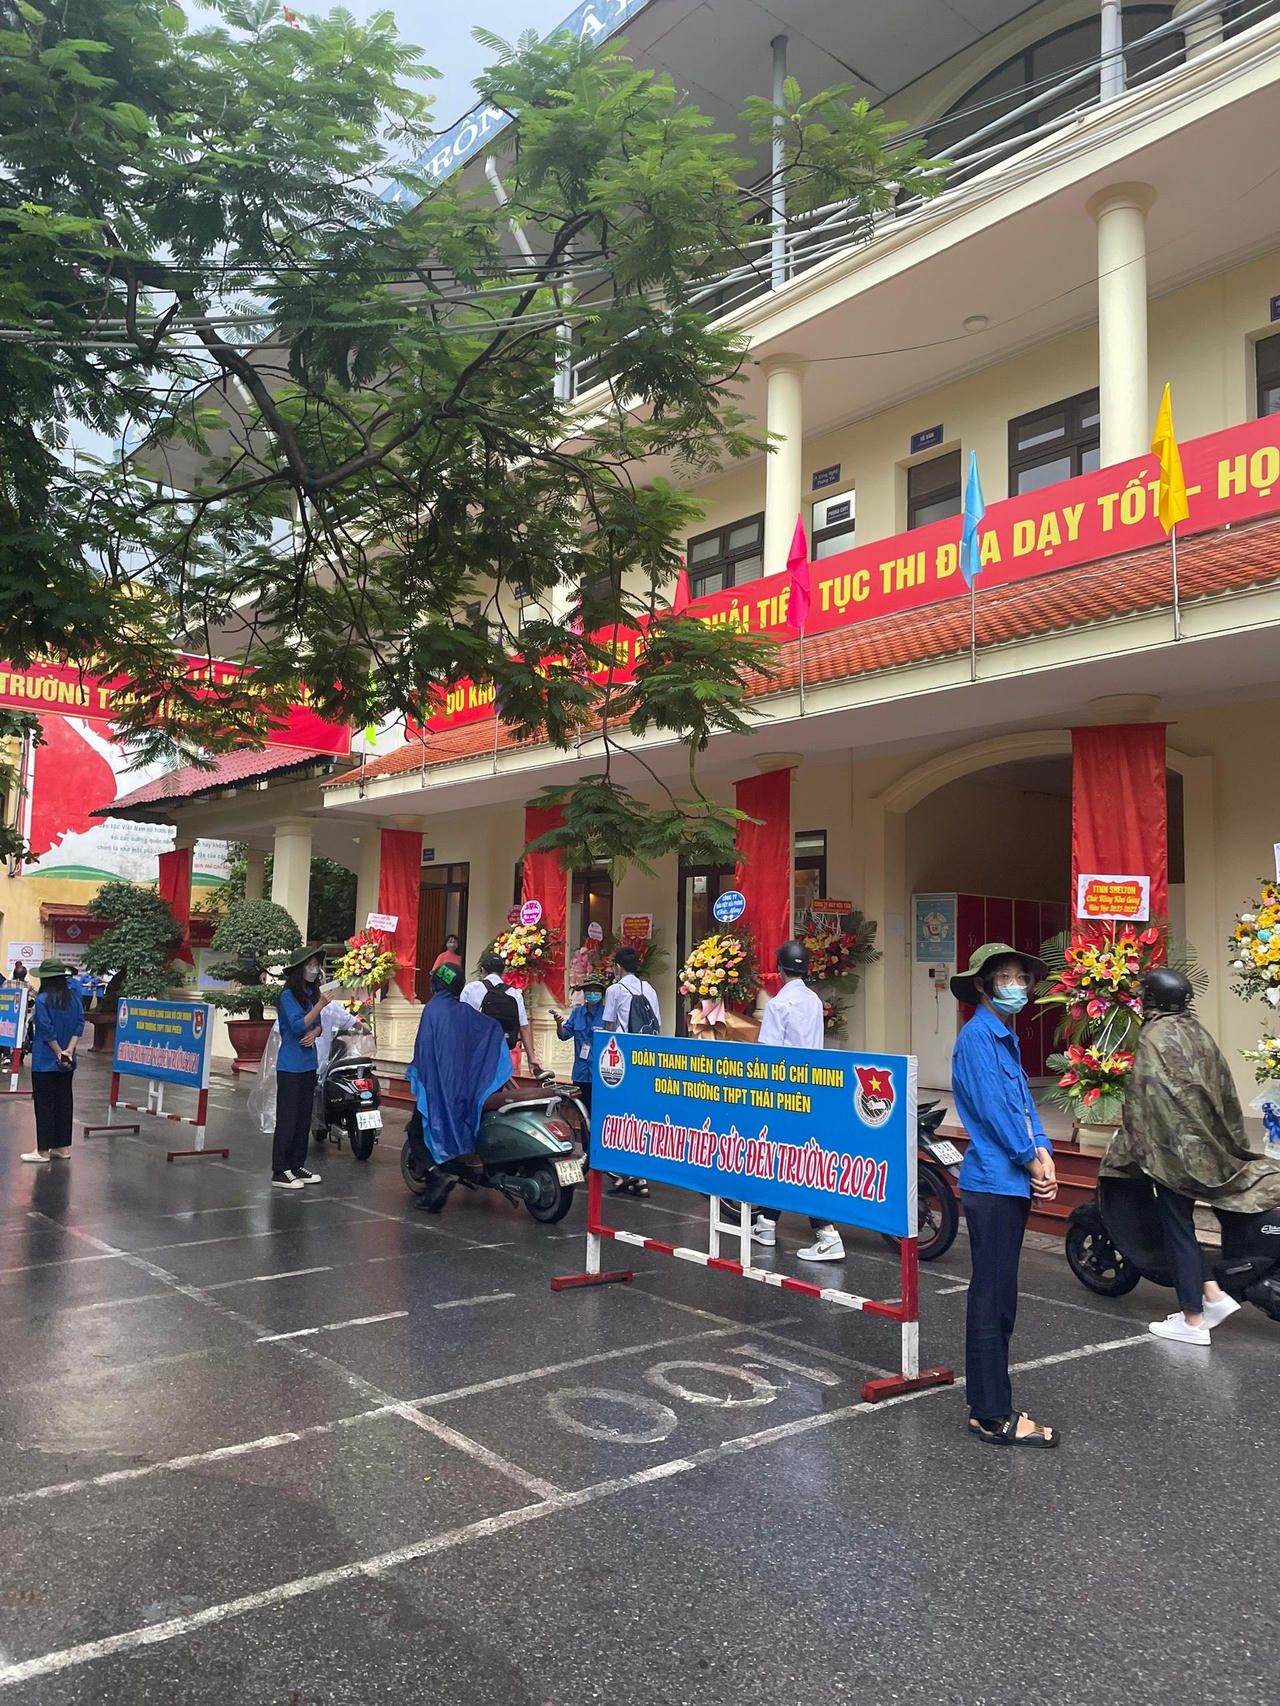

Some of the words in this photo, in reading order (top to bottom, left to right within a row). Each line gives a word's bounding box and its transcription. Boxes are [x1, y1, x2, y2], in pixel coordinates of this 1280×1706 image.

[818, 569, 870, 614] TỤC
[880, 551, 926, 594] THI
[935, 530, 1001, 579] ĐA
[1013, 502, 1086, 558] DẠY
[0, 672, 90, 707] TRƯỜNG
[631, 1049, 656, 1067] ĐOÀN
[658, 1052, 687, 1071] THANH
[690, 1055, 713, 1074] NIÊN
[716, 1057, 743, 1079] CỘNG
[746, 1057, 768, 1079] SẢN
[771, 1059, 786, 1082] HỒ
[789, 1064, 809, 1084] CHÍ
[811, 1067, 844, 1088] MINH
[655, 1076, 680, 1096] ĐOÀN
[682, 1080, 720, 1102] TRƯỜNG
[723, 1086, 748, 1105] THPT
[750, 1087, 773, 1109] THÁI
[776, 1092, 811, 1113] PHIÊN
[602, 1112, 648, 1155] CHƯƠNG
[649, 1114, 687, 1162] TRÌNH
[687, 1117, 718, 1168] TIẾP
[717, 1125, 745, 1173] SỨC
[746, 1125, 776, 1180] ĐẾN
[777, 1137, 838, 1192] TRƯỜNG
[838, 1153, 888, 1202] 2021
